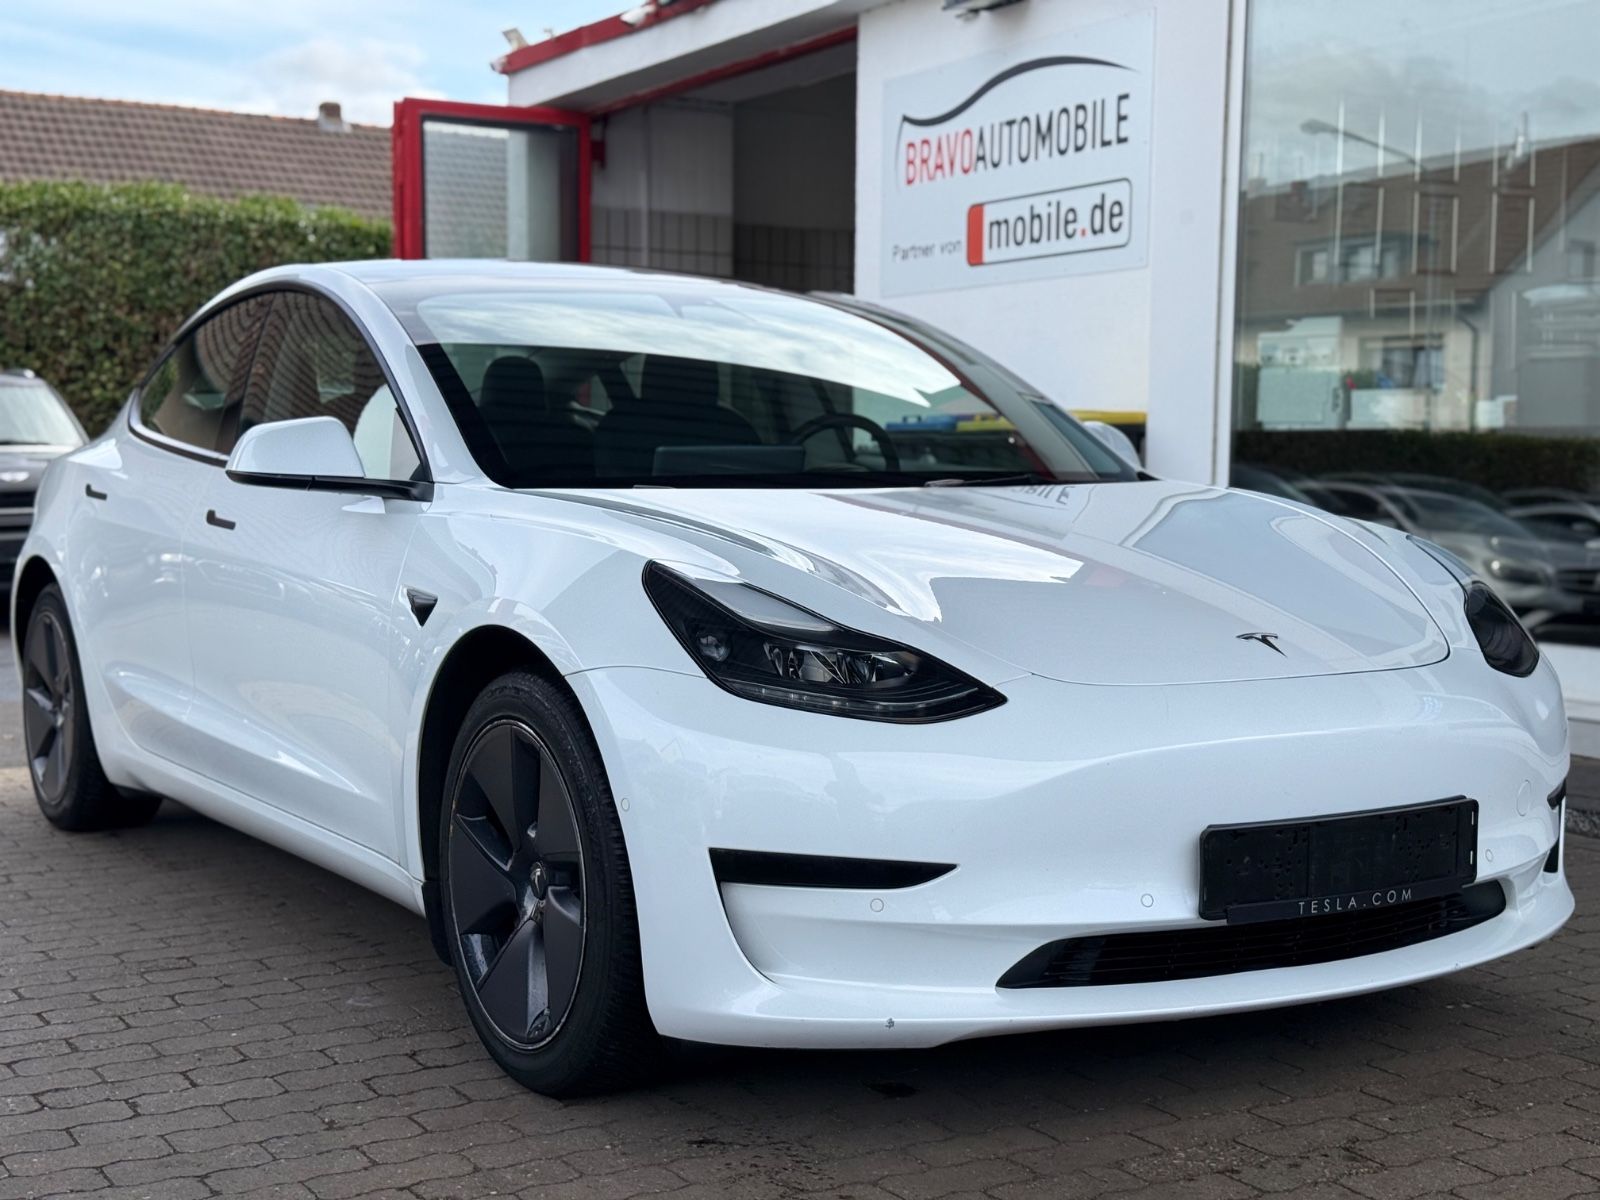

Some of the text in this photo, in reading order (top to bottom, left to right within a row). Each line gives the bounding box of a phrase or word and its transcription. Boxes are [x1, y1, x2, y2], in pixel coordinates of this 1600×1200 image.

[904, 93, 1131, 187] BRAVOAUTOMOBILE
[892, 193, 1125, 263] Partner von mobile.de
[1299, 888, 1413, 915] TESLA.COM
